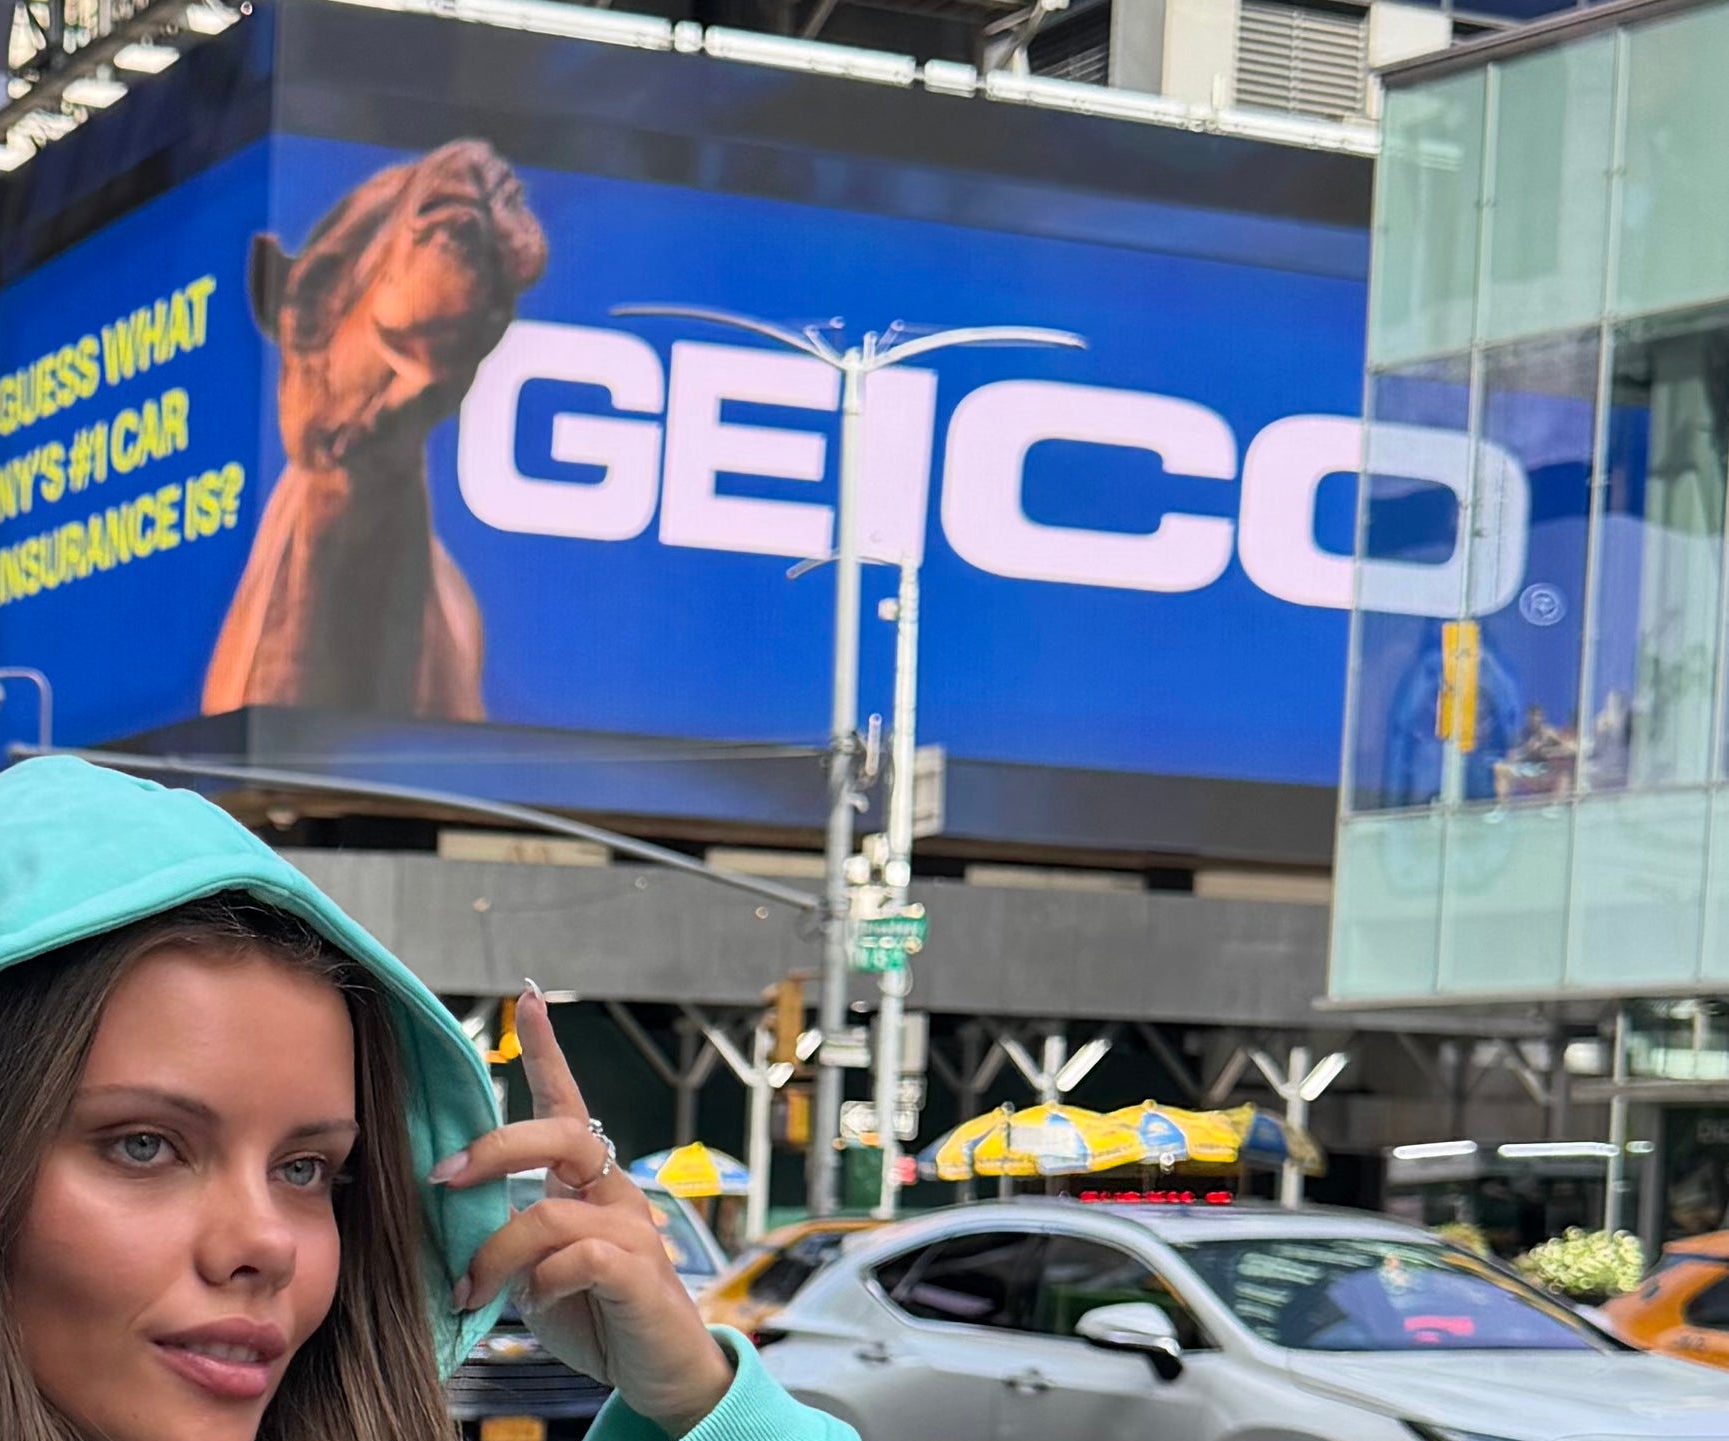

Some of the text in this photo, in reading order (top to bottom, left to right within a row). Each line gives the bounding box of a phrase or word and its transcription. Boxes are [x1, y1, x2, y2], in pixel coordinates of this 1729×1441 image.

[101, 274, 217, 386] WHAT
[68, 420, 109, 493] #1
[110, 387, 189, 474] CAR
[458, 320, 1531, 620] GEICO
[183, 461, 245, 542] IS?
